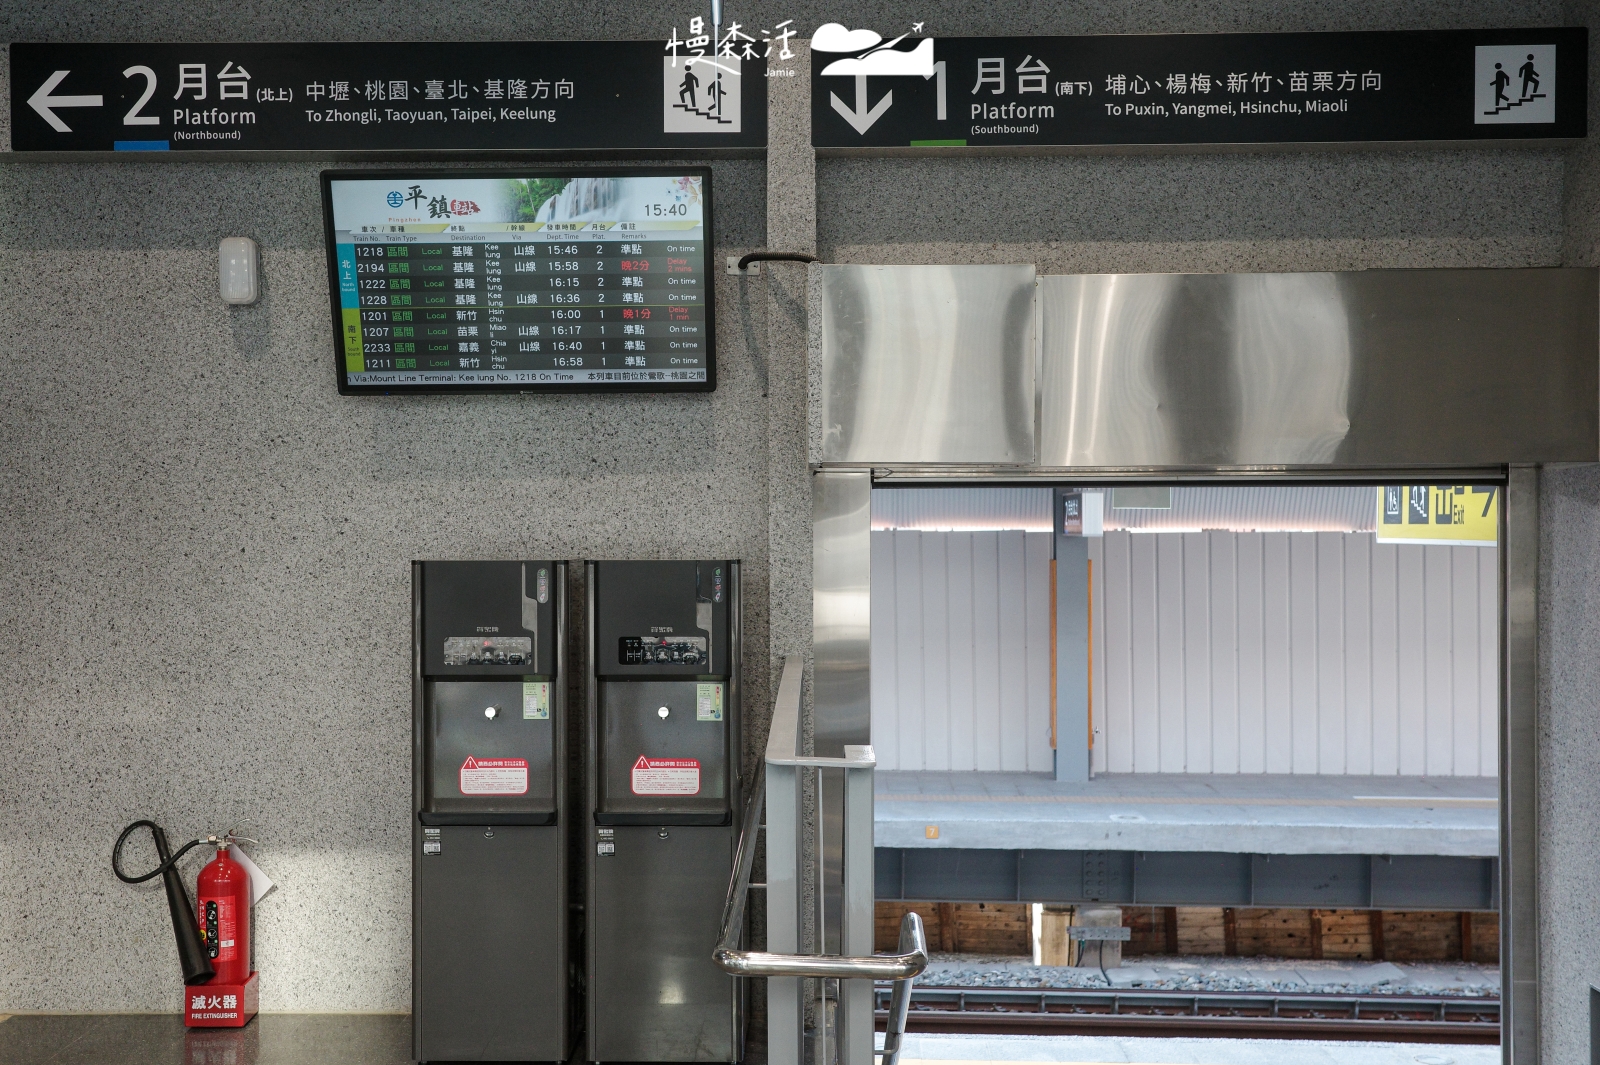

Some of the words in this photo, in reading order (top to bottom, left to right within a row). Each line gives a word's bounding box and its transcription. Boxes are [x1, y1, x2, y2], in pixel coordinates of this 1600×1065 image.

[971, 54, 1051, 96] 月台
[1055, 81, 1094, 97] (南下)
[122, 65, 161, 126] 2
[173, 61, 252, 101] 月台
[256, 87, 294, 103] (北上)
[971, 102, 1055, 120] Platform
[1105, 103, 1122, 116] To
[1125, 102, 1170, 118] Puxin,
[1172, 101, 1237, 118] Yangmei,
[1240, 100, 1303, 116] Hsinchu,
[1305, 99, 1348, 113] Miaoli
[173, 108, 257, 126] Platform
[305, 110, 322, 122] To
[325, 109, 382, 125] Zhongli,
[385, 108, 448, 124] Taoyuan,
[451, 107, 497, 123] Taipei,
[500, 106, 557, 123] Keelung
[971, 123, 1040, 136] (Southbound)
[173, 130, 242, 142] (Northbound)
[404, 184, 452, 219] 平鎮
[645, 203, 687, 217] 15:40
[361, 225, 377, 233] 車次
[591, 223, 606, 231] 月台
[402, 235, 418, 243] Type
[547, 233, 563, 241] Dept.
[357, 247, 384, 257] 1218
[452, 245, 474, 257] 基隆
[514, 245, 536, 256] 山線
[548, 245, 578, 255] 15:46
[596, 245, 603, 254] 2
[342, 260, 352, 280] 北上
[357, 263, 385, 273] 2194
[453, 262, 475, 273] 基隆
[515, 261, 537, 273] 山線
[549, 261, 579, 271] 15:58
[597, 261, 604, 271] 2
[486, 267, 502, 275] lung
[360, 280, 386, 289] 1222
[454, 278, 476, 289] 基隆
[549, 278, 580, 287] 16:15
[598, 277, 604, 287] 2
[361, 296, 388, 305] 1228
[455, 294, 477, 305] 基隆
[517, 293, 538, 305] 山線
[550, 294, 580, 303] 16:36
[598, 294, 605, 303] 2
[362, 311, 388, 321] 1201
[456, 310, 478, 321] 新竹
[551, 310, 581, 319] 16:00
[599, 309, 604, 319] 1
[363, 327, 389, 337] 1207
[457, 326, 479, 337] 苗栗
[518, 325, 540, 336] 山線
[552, 326, 582, 335] 16:17
[600, 325, 605, 334] 1
[364, 343, 391, 353] 2233
[458, 342, 480, 353] 嘉義
[519, 341, 541, 352] 山線
[552, 341, 582, 351] 16:40
[601, 341, 605, 350] 1
[365, 359, 391, 368] 1211
[459, 358, 480, 369] 新竹
[553, 357, 583, 367] 16:58
[601, 357, 606, 366] 1
[398, 374, 417, 382] Line
[419, 373, 456, 382] Terminal:
[459, 373, 475, 382] Kee
[477, 373, 494, 384] lung
[496, 373, 512, 381] No.
[515, 373, 537, 381] 1218
[539, 373, 551, 381] On
[553, 373, 574, 381] Time
[191, 994, 238, 1010] 滅火器
